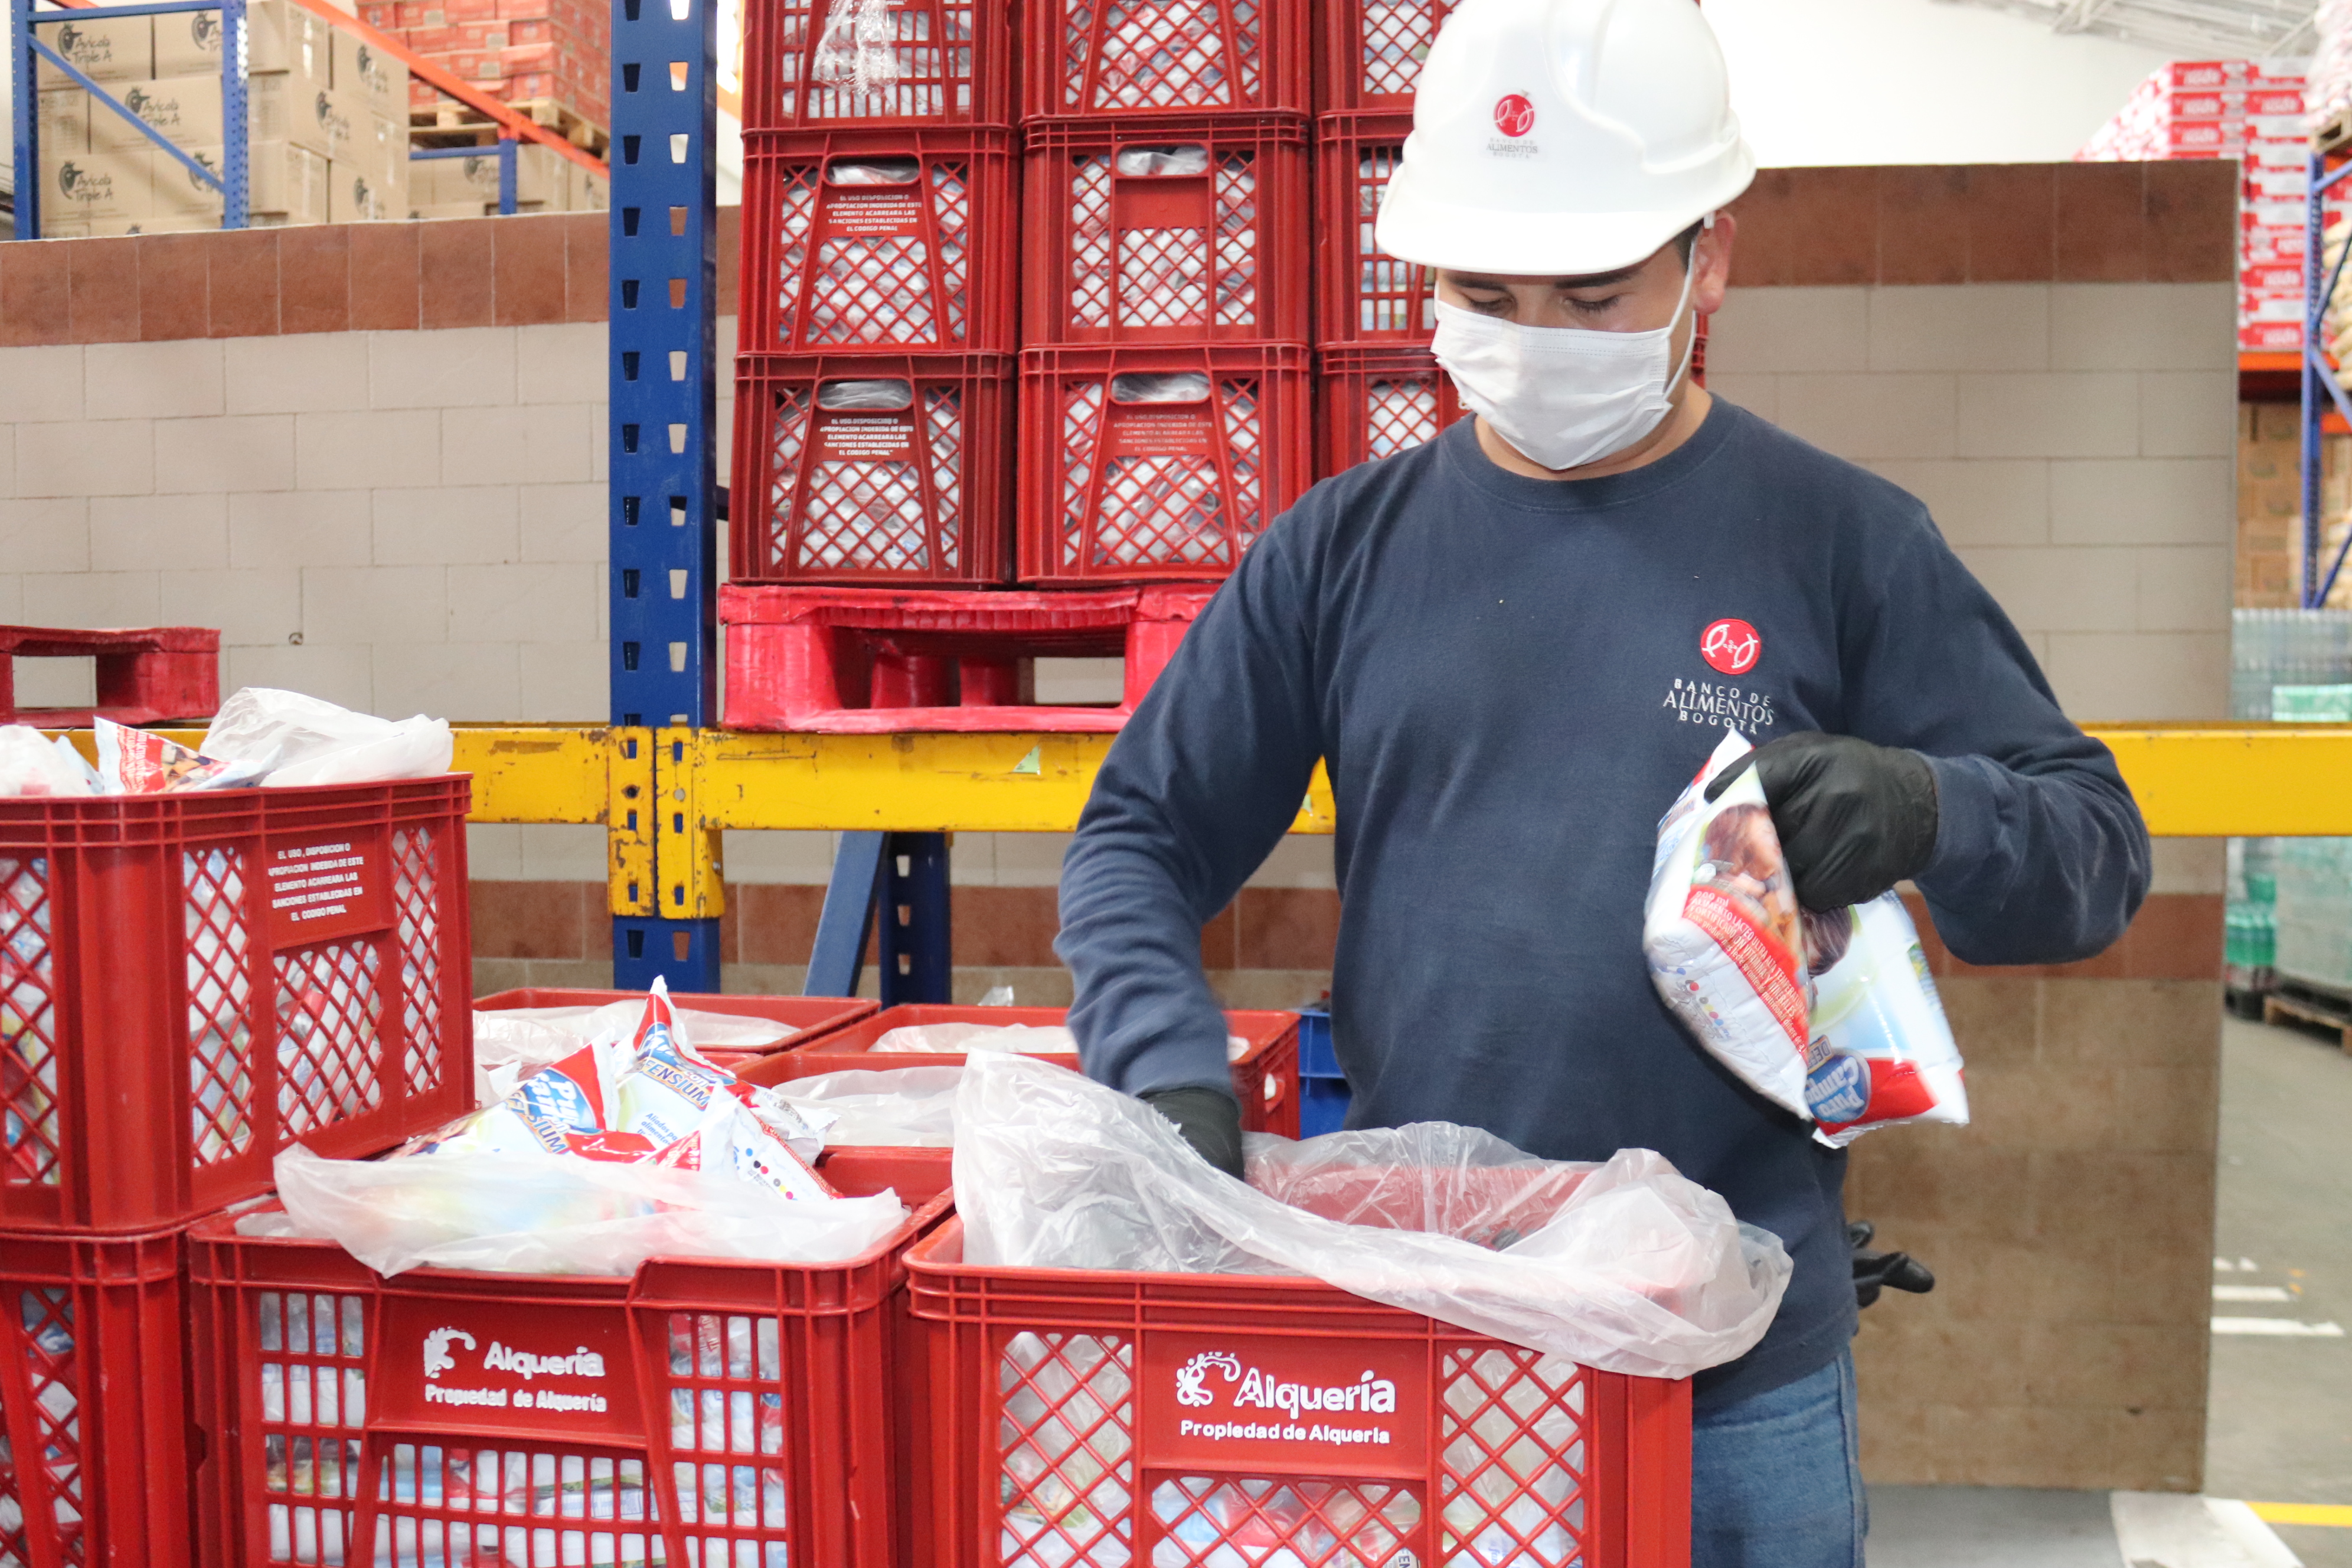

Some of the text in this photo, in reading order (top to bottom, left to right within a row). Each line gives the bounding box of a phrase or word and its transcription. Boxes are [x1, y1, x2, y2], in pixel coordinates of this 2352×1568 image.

[1486, 143, 1538, 154] ALIMENTOS
[1674, 678, 1770, 707] BANCO DE
[1662, 690, 1775, 726] ALIMENTOS
[277, 850, 286, 860] EL
[344, 842, 351, 851] O
[338, 858, 347, 867] DE
[347, 856, 364, 867] ESTE
[274, 871, 358, 892] ELEMENTO ACARREARA LAS
[272, 886, 364, 909] SANCIONES ESTABLECIDAS EN
[290, 904, 347, 921] EL CODIGO PENAL
[1690, 905, 1737, 939] FORTIFICADO
[1751, 935, 1769, 961] ULTRA
[683, 1070, 710, 1089] con
[1817, 1084, 1866, 1116] Puro
[645, 1113, 678, 1141] Aliados pa
[425, 1383, 508, 1407] Propiedad
[513, 1389, 534, 1407] de
[1233, 1367, 1396, 1419] Alquería
[1180, 1419, 1280, 1440] Propiedad
[1282, 1423, 1306, 1441] de
